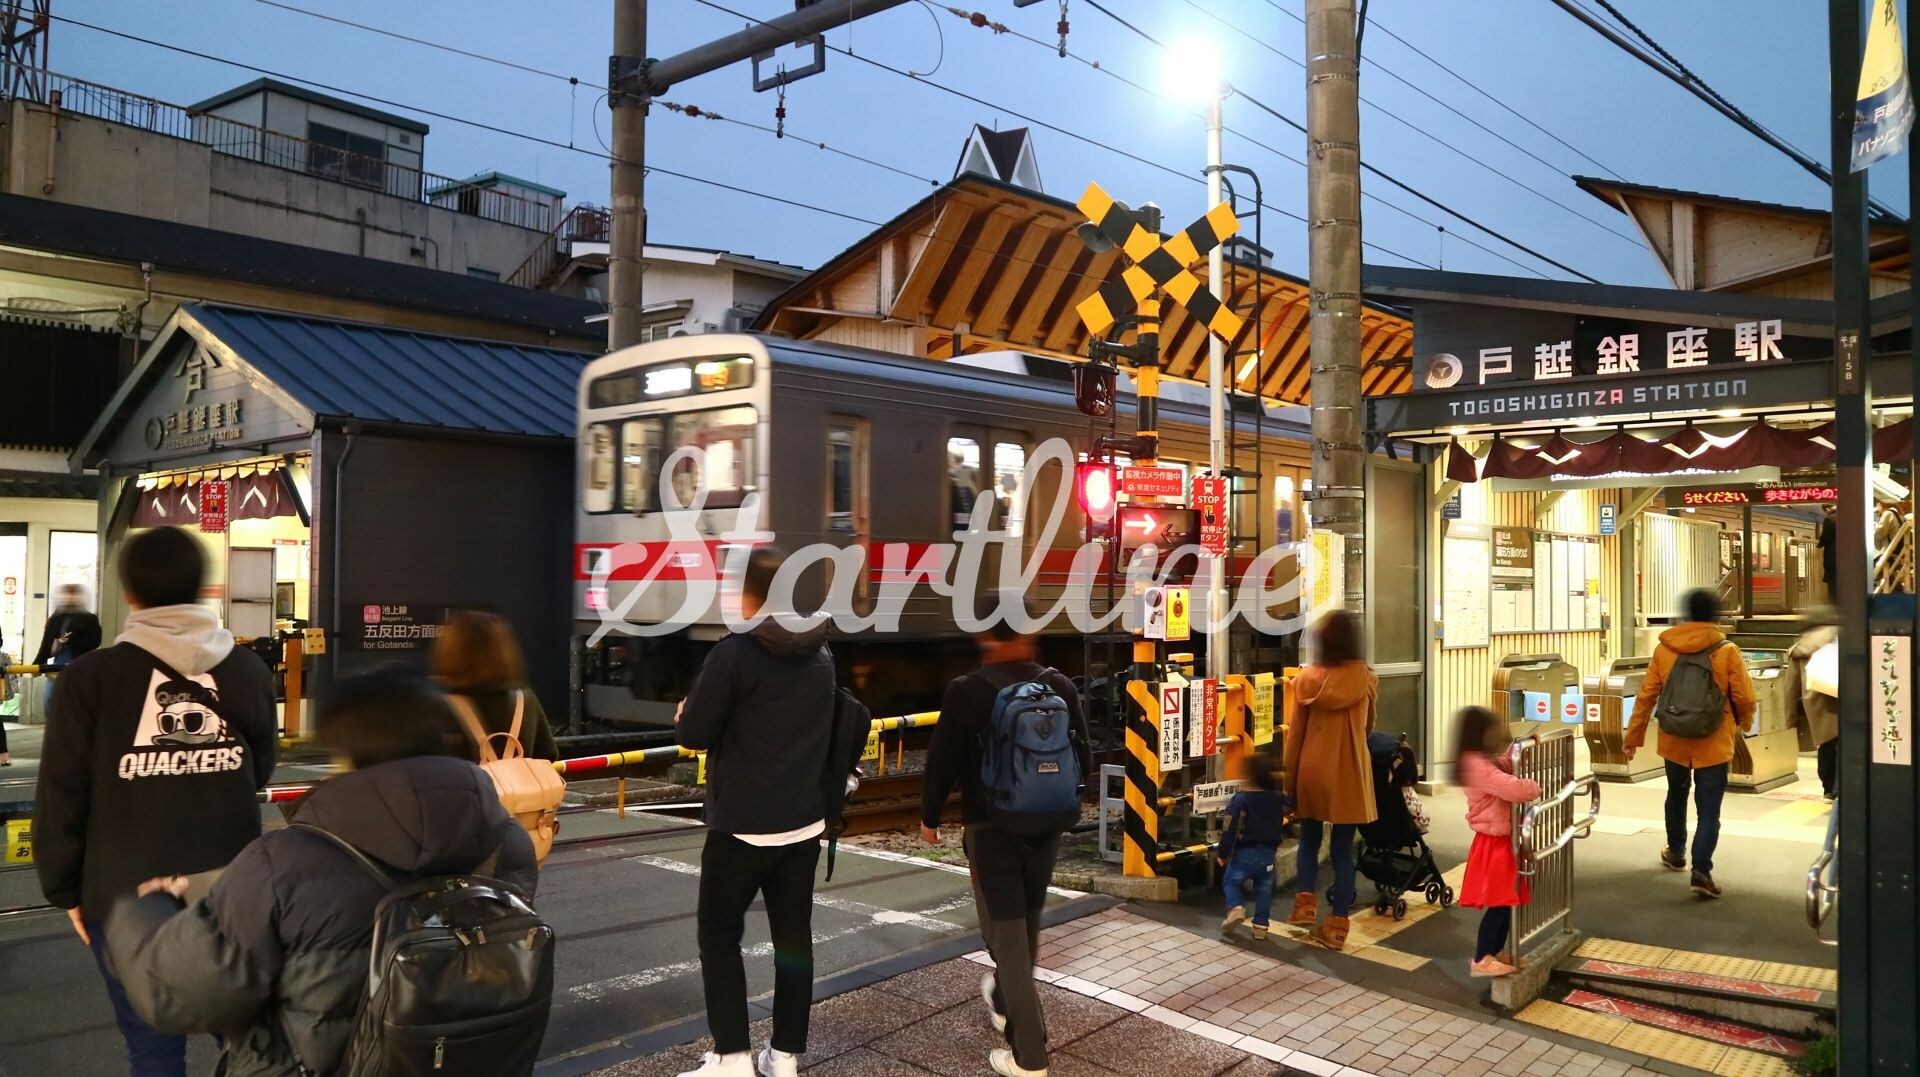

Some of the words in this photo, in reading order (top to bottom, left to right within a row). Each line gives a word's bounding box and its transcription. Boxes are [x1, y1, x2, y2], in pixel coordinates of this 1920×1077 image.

[1479, 319, 1785, 385] 戸越銀座駅
[1449, 388, 1624, 416] TOGOSHIGINZA
[1633, 379, 1748, 403] STATION
[1125, 470, 1181, 480] 監視カメラ作動中
[1197, 495, 1220, 504] STOP
[382, 605, 408, 615] 池上線
[363, 641, 375, 649] for
[377, 641, 414, 649] Gotanda
[1205, 684, 1214, 751] 非常ボタン
[1163, 718, 1171, 765] 立入禁止
[1172, 717, 1180, 763] 係員以外
[118, 746, 244, 781] QUACKERS
